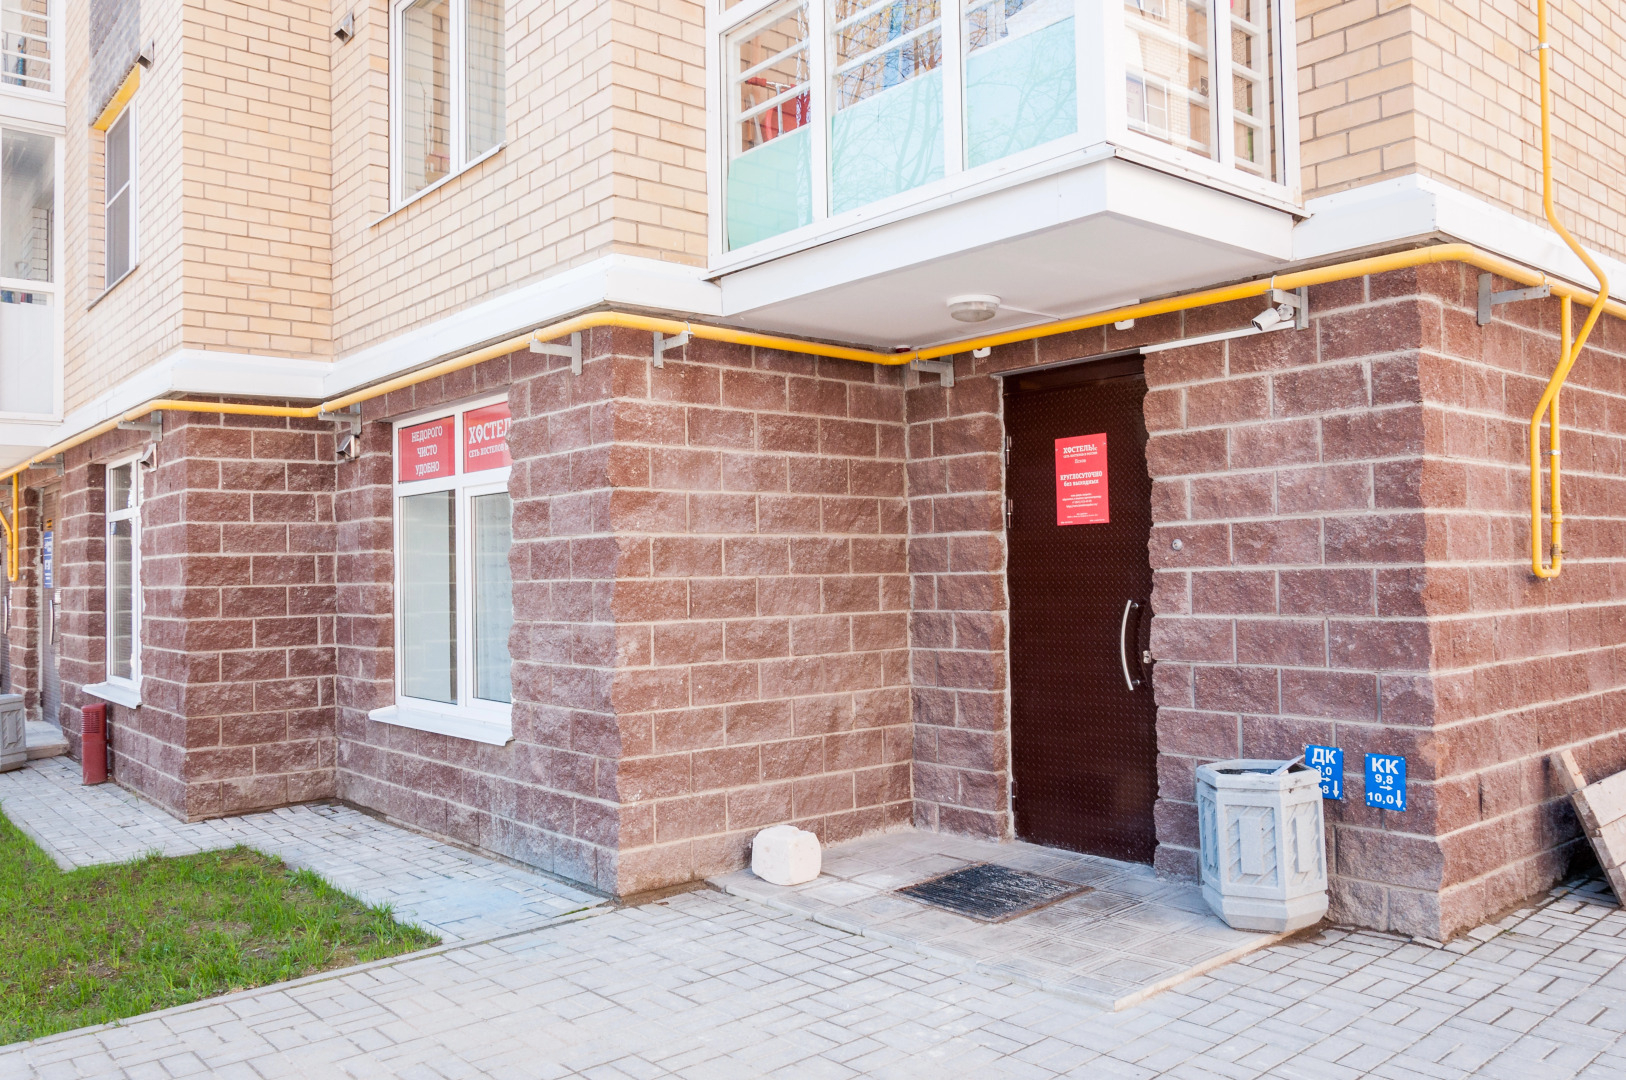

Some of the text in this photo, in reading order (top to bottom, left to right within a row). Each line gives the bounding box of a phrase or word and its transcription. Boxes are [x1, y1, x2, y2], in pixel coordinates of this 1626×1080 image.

[411, 425, 443, 443] НЕДОРОГО
[417, 444, 438, 458] ЧИСТО
[469, 449, 480, 458] СЕТЬ
[415, 461, 440, 477] УДОБНО
[1060, 470, 1103, 480] КРУГЛОСУТОЧНО
[1311, 748, 1337, 765] ДК
[1371, 757, 1399, 775] КК
[1374, 774, 1394, 785] 9,8
[1367, 791, 1394, 805] 10,0
